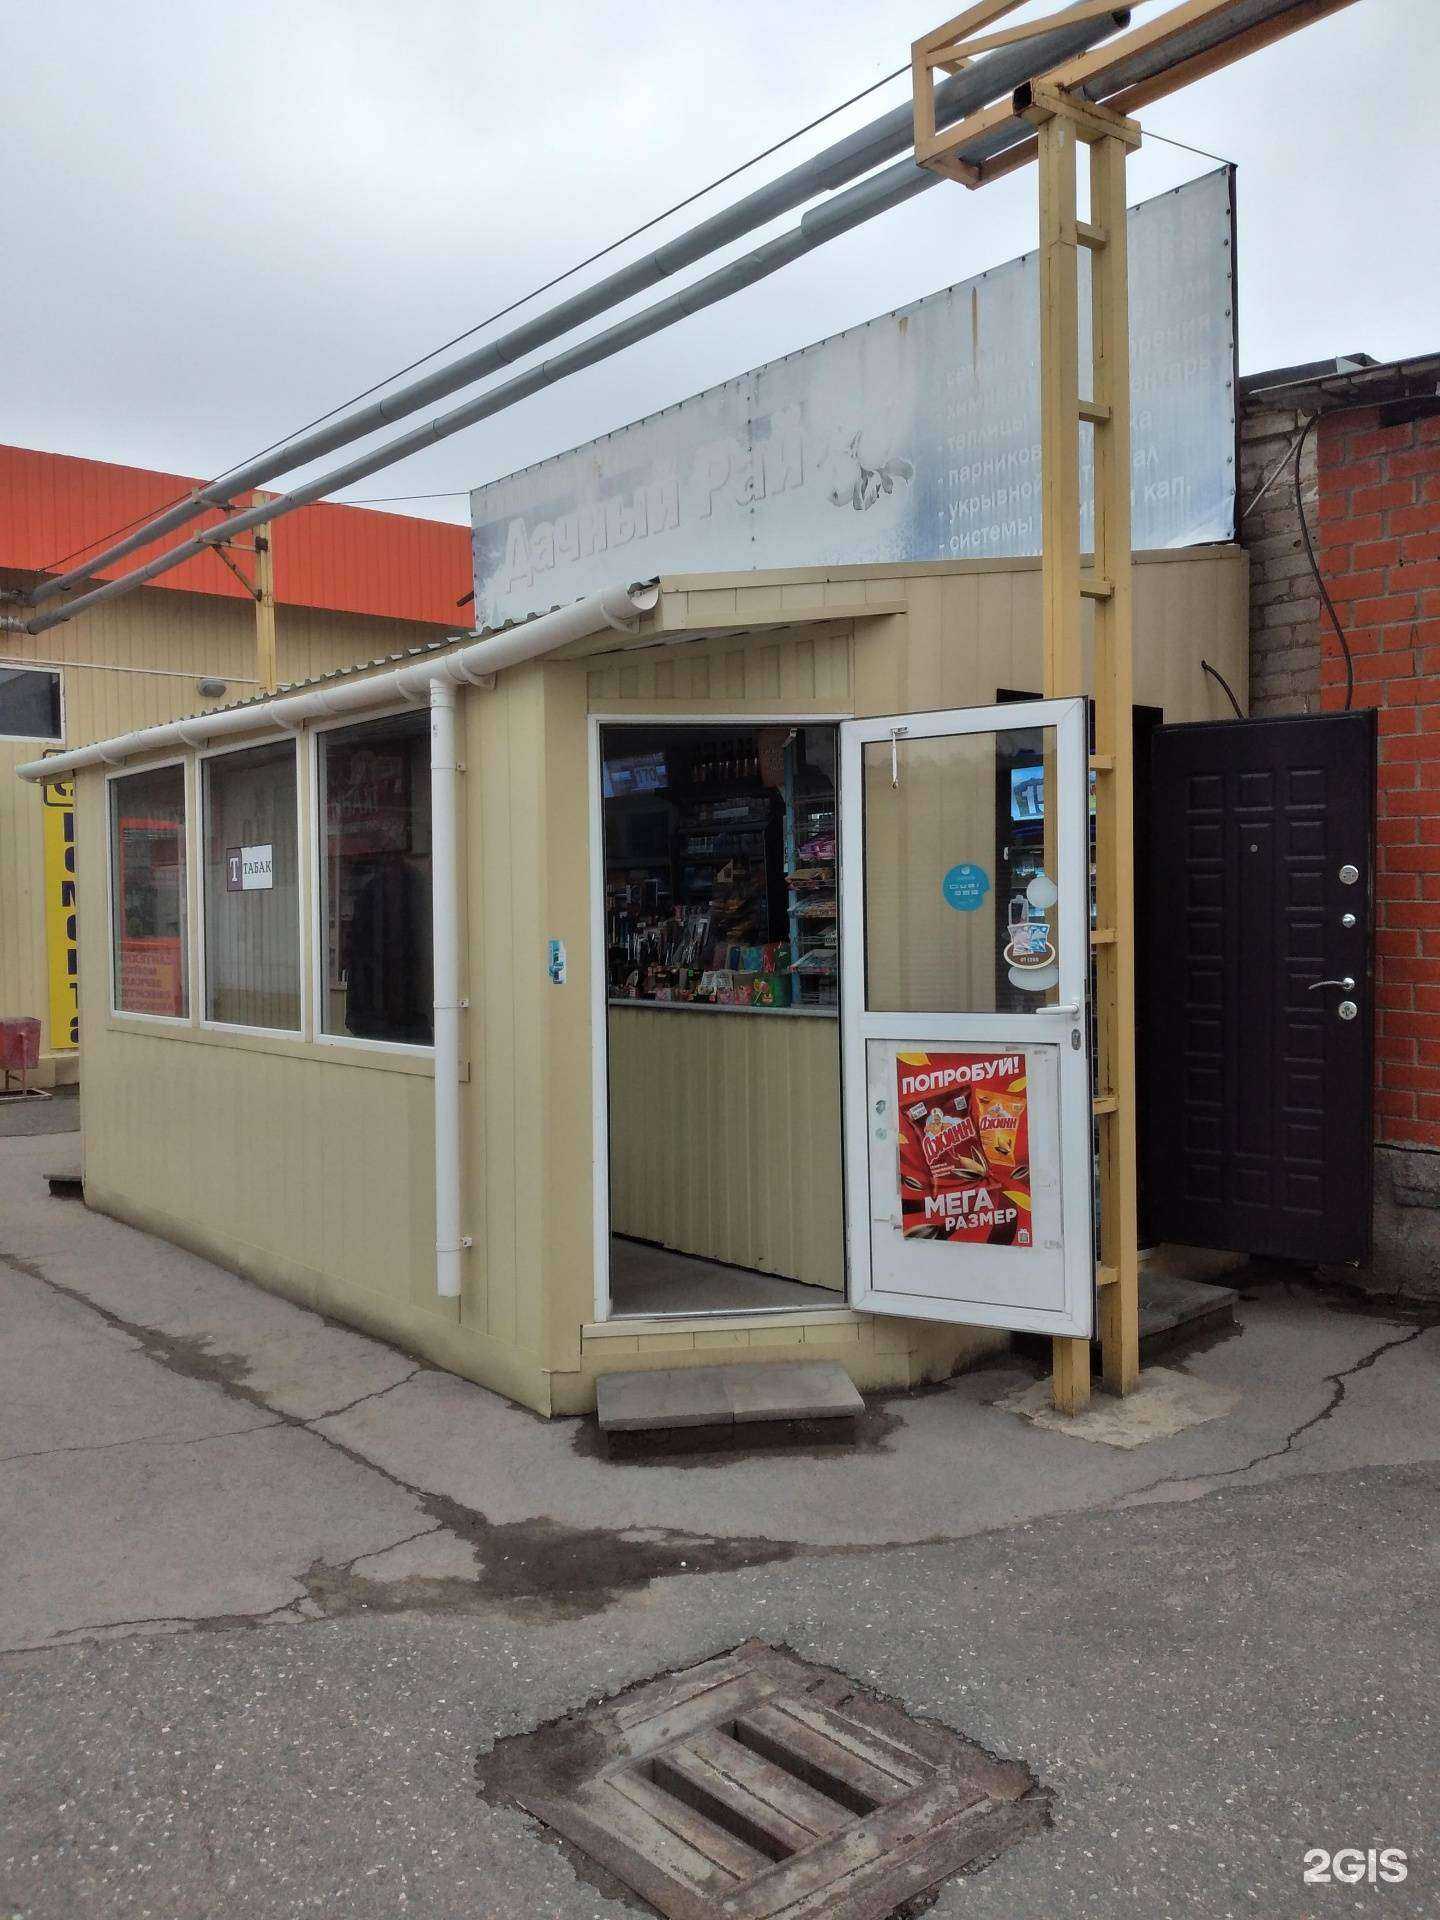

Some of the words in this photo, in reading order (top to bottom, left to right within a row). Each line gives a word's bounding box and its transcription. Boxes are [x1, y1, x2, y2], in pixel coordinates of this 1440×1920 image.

[949, 445, 1041, 484] парников
[243, 860, 272, 874] ТАБАК
[902, 1056, 1019, 1094] ПОПРОБУЙ!
[925, 1188, 994, 1218] МЕГА
[945, 1208, 1017, 1231] РАЗМЕР
